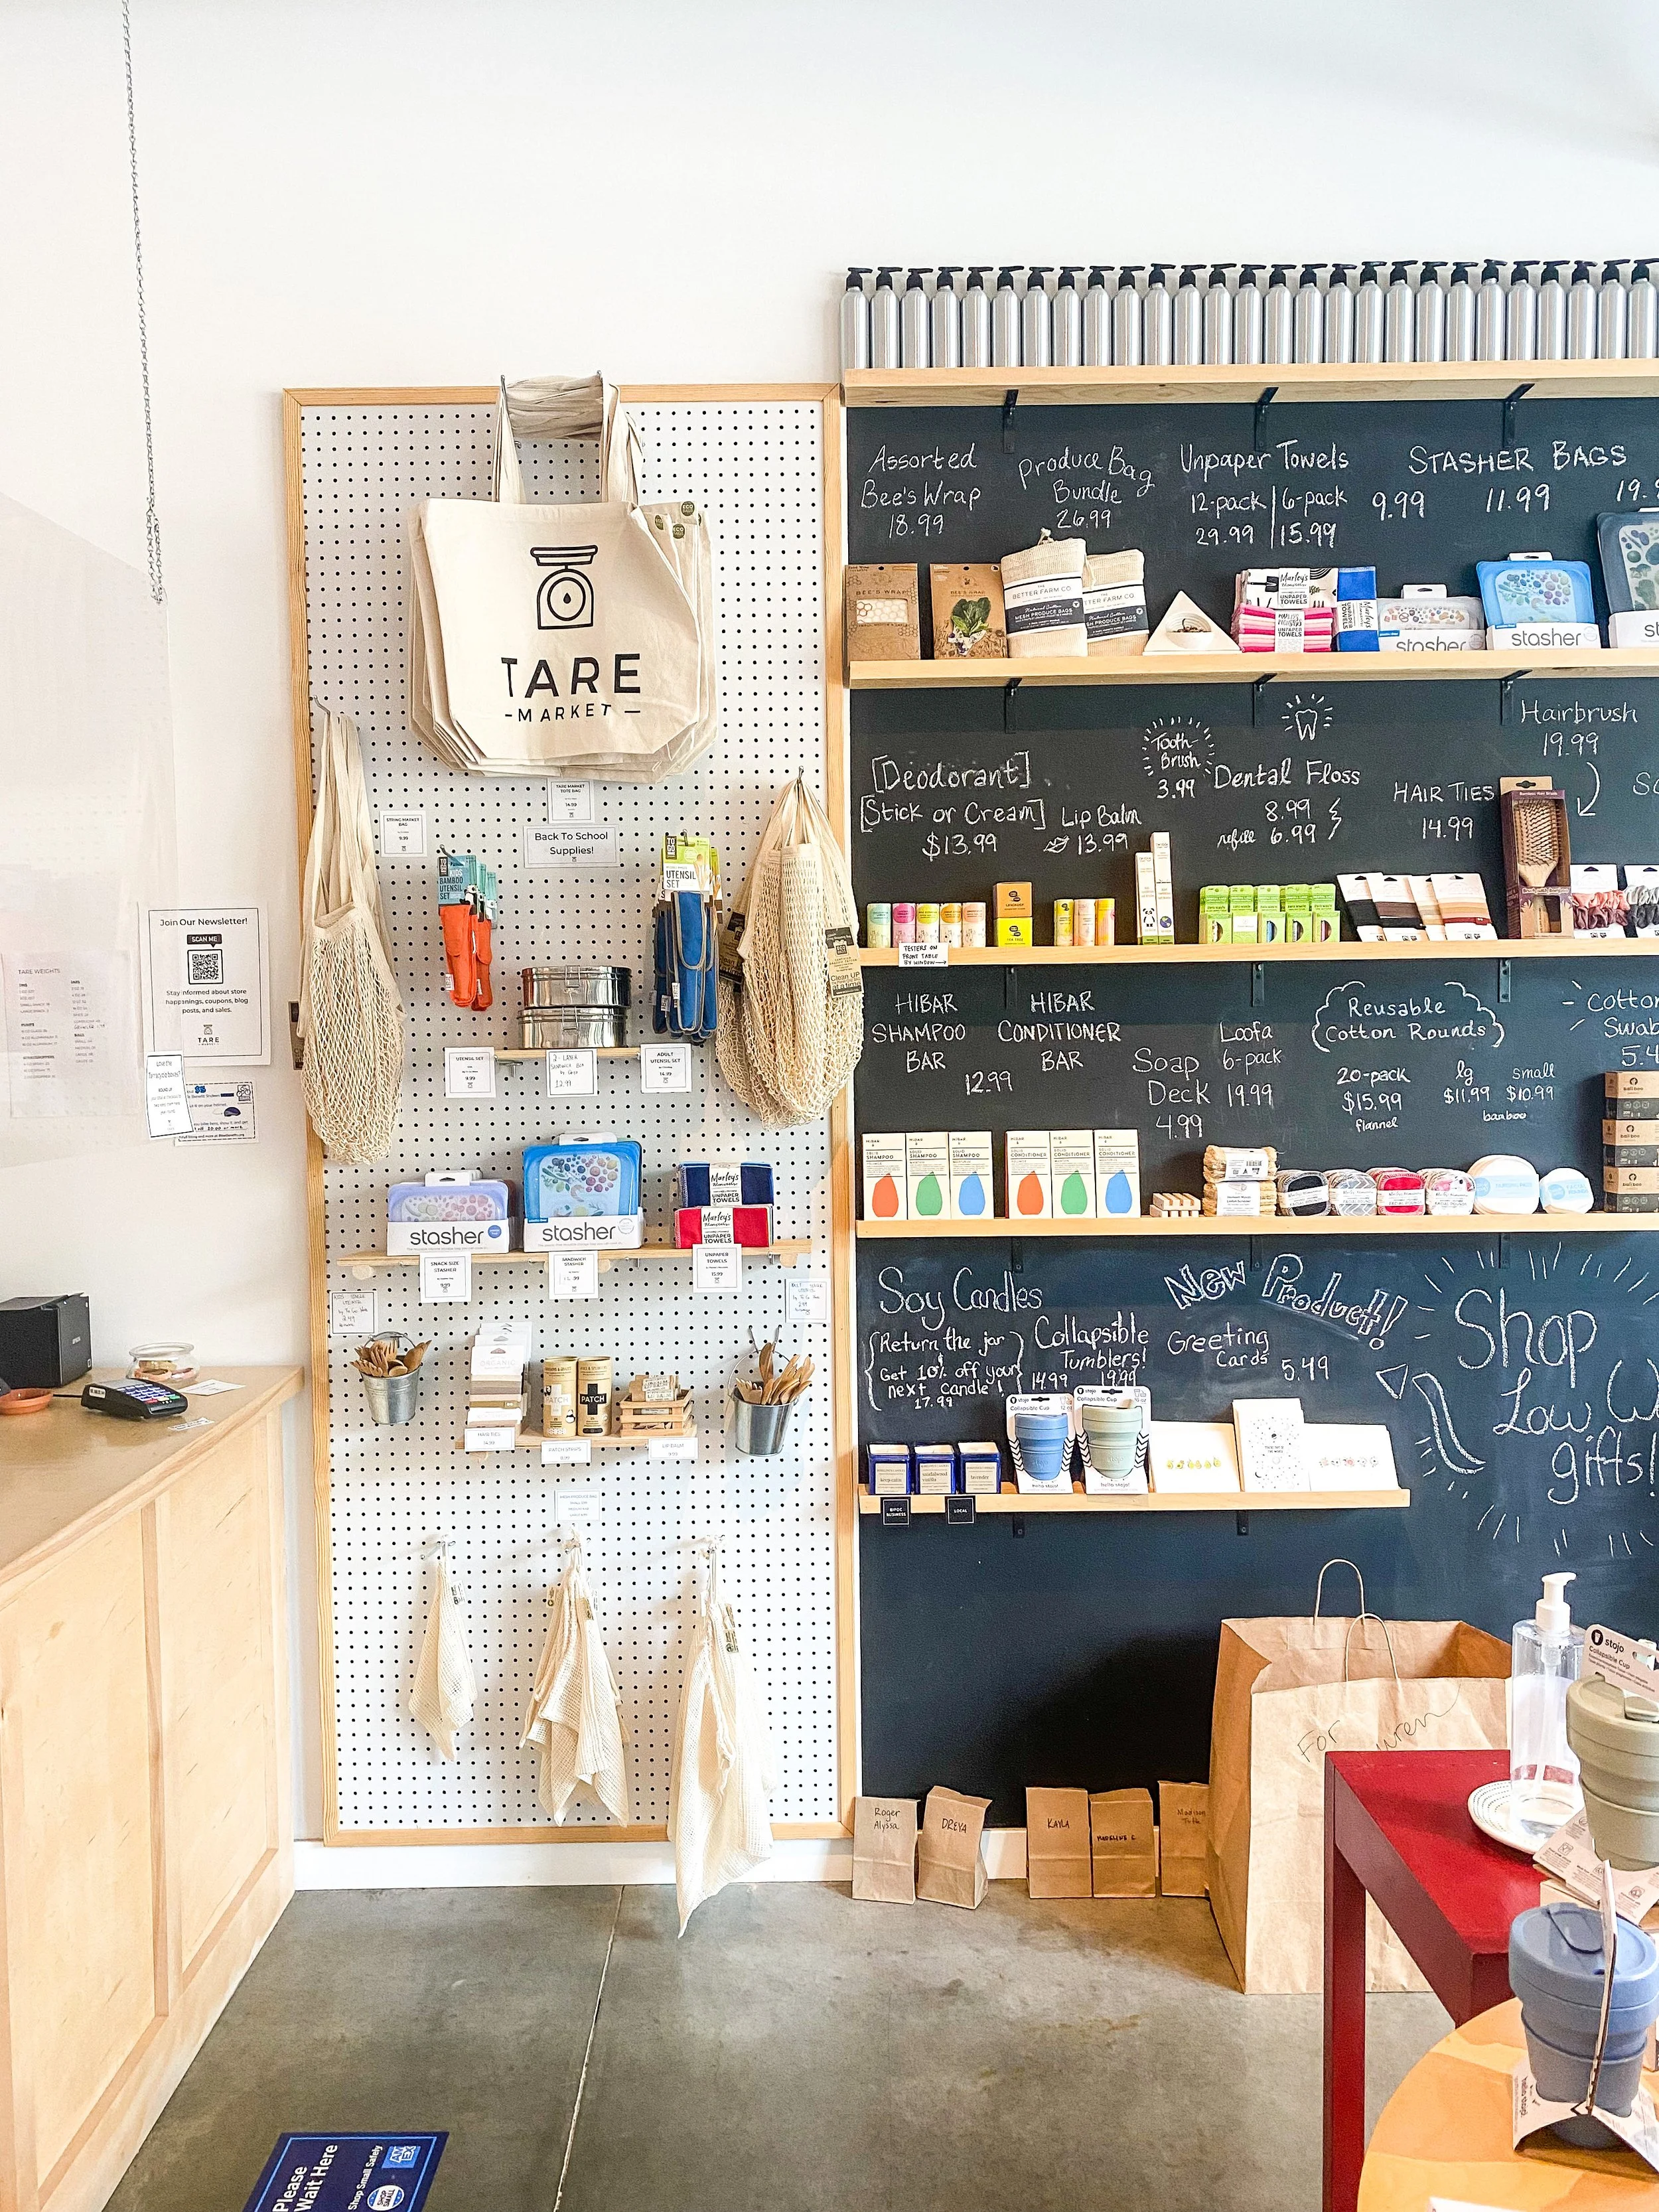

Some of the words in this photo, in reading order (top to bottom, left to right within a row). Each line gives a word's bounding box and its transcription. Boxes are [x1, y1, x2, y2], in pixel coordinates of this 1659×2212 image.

[869, 443, 977, 473] Assorted
[1181, 443, 1271, 482] Unpaper
[1276, 439, 1348, 470] Towels
[1409, 446, 1534, 474] STASHER
[1552, 441, 1626, 470] BAGS
[1108, 445, 1155, 497] Bag
[861, 479, 916, 508] Bee's
[924, 480, 980, 511] Wrap
[1053, 479, 1121, 504] Bundle
[1283, 485, 1347, 517] 6-pack
[1486, 484, 1550, 512] 11.99
[1192, 491, 1267, 519] 12-pack
[1372, 491, 1424, 521] 9.99
[889, 514, 943, 538] 18.99
[1056, 509, 1110, 528] 26.99
[1196, 525, 1253, 546] 29.99
[1281, 522, 1336, 548] 15.99
[1280, 571, 1308, 583] Marley's
[1012, 590, 1039, 600] BETTER
[1511, 628, 1581, 647] stasher
[501, 652, 642, 698] TARE
[1522, 700, 1638, 724] Hairbrush
[1544, 732, 1599, 757] 19.99
[1161, 751, 1201, 770] Brush
[1214, 758, 1291, 788] Dental
[1307, 761, 1360, 784] Floss
[1157, 779, 1195, 798] 3.99
[1394, 782, 1444, 802] HAIR
[1449, 782, 1494, 801] TIES
[933, 808, 956, 824] or
[1062, 807, 1091, 829] Lip
[1097, 803, 1142, 827] Balm
[1265, 798, 1310, 821] 8.99
[1271, 824, 1316, 844] 6.99
[1423, 816, 1473, 841] 14.99
[549, 846, 594, 856] Supplies!
[922, 831, 997, 861] $13.99
[1078, 834, 1127, 855] 13.99
[666, 870, 696, 879] UTENSIL
[666, 879, 680, 888] SET
[895, 993, 958, 1015] HIBAR
[1031, 991, 1095, 1013] HIBAR
[1348, 997, 1445, 1017] Reusable
[872, 1023, 965, 1043] SHAMPOO
[998, 1020, 1121, 1043] CONDITIONER
[1220, 1021, 1273, 1042] Loofa
[1326, 1023, 1396, 1042] Cotton
[1407, 1020, 1486, 1040] Rounds
[907, 1051, 946, 1072] BAR
[1041, 1051, 1083, 1071] BAR
[1133, 1048, 1199, 1080] Soap
[1223, 1049, 1281, 1075] 6-pack
[1456, 1060, 1473, 1086] lg
[1512, 1062, 1555, 1079] small
[966, 1071, 1013, 1096] 12.99
[1336, 1068, 1411, 1088] 20-pack
[1149, 1079, 1210, 1105] Deck
[1228, 1084, 1273, 1109] 19.99
[1342, 1091, 1402, 1115] $15.99
[1444, 1086, 1489, 1104] $11.99
[1506, 1085, 1553, 1102] $10.99
[1156, 1114, 1202, 1140] 4.99
[1356, 1117, 1398, 1132] flannel
[410, 1226, 484, 1245] stasher
[542, 1221, 616, 1242] stasher
[1164, 1260, 1246, 1309] New
[879, 1267, 945, 1331] Soy
[954, 1268, 1042, 1312] Candles
[881, 1331, 939, 1353] Return
[943, 1327, 972, 1351] the
[978, 1331, 1005, 1357] jar
[1035, 1311, 1148, 1350] Collapsible
[1167, 1322, 1268, 1355] Greeting
[1455, 1288, 1597, 1388] Shop
[1060, 1346, 1146, 1372] Tumblers!
[1216, 1349, 1267, 1366] Cards
[1282, 1356, 1329, 1380] 5.49
[881, 1365, 907, 1381] Get
[917, 1365, 947, 1380] 10%
[955, 1361, 980, 1378] off
[985, 1364, 1019, 1385] your
[1033, 1372, 1067, 1390] 14.99
[889, 1383, 926, 1398] next
[941, 1379, 988, 1396] candle
[915, 1396, 952, 1409] 17.99
[1493, 1367, 1591, 1435] Low
[1548, 1426, 1656, 1505] gifts!
[1589, 1646, 1617, 1662] Collapsible
[1619, 1659, 1630, 1669] Cup
[1605, 1639, 1624, 1653] stojo
[1297, 1720, 1340, 1763] For
[874, 1807, 901, 1822] Roger
[1047, 1818, 1070, 1829] KAYLA
[873, 1821, 899, 1833] Alyssa
[273, 2166, 308, 2212] Please
[293, 2179, 324, 2212] Wait
[309, 2144, 338, 2177] Here
[348, 2190, 364, 2210] Shop
[356, 2168, 372, 2189] Small
[366, 2145, 383, 2168] Safely
